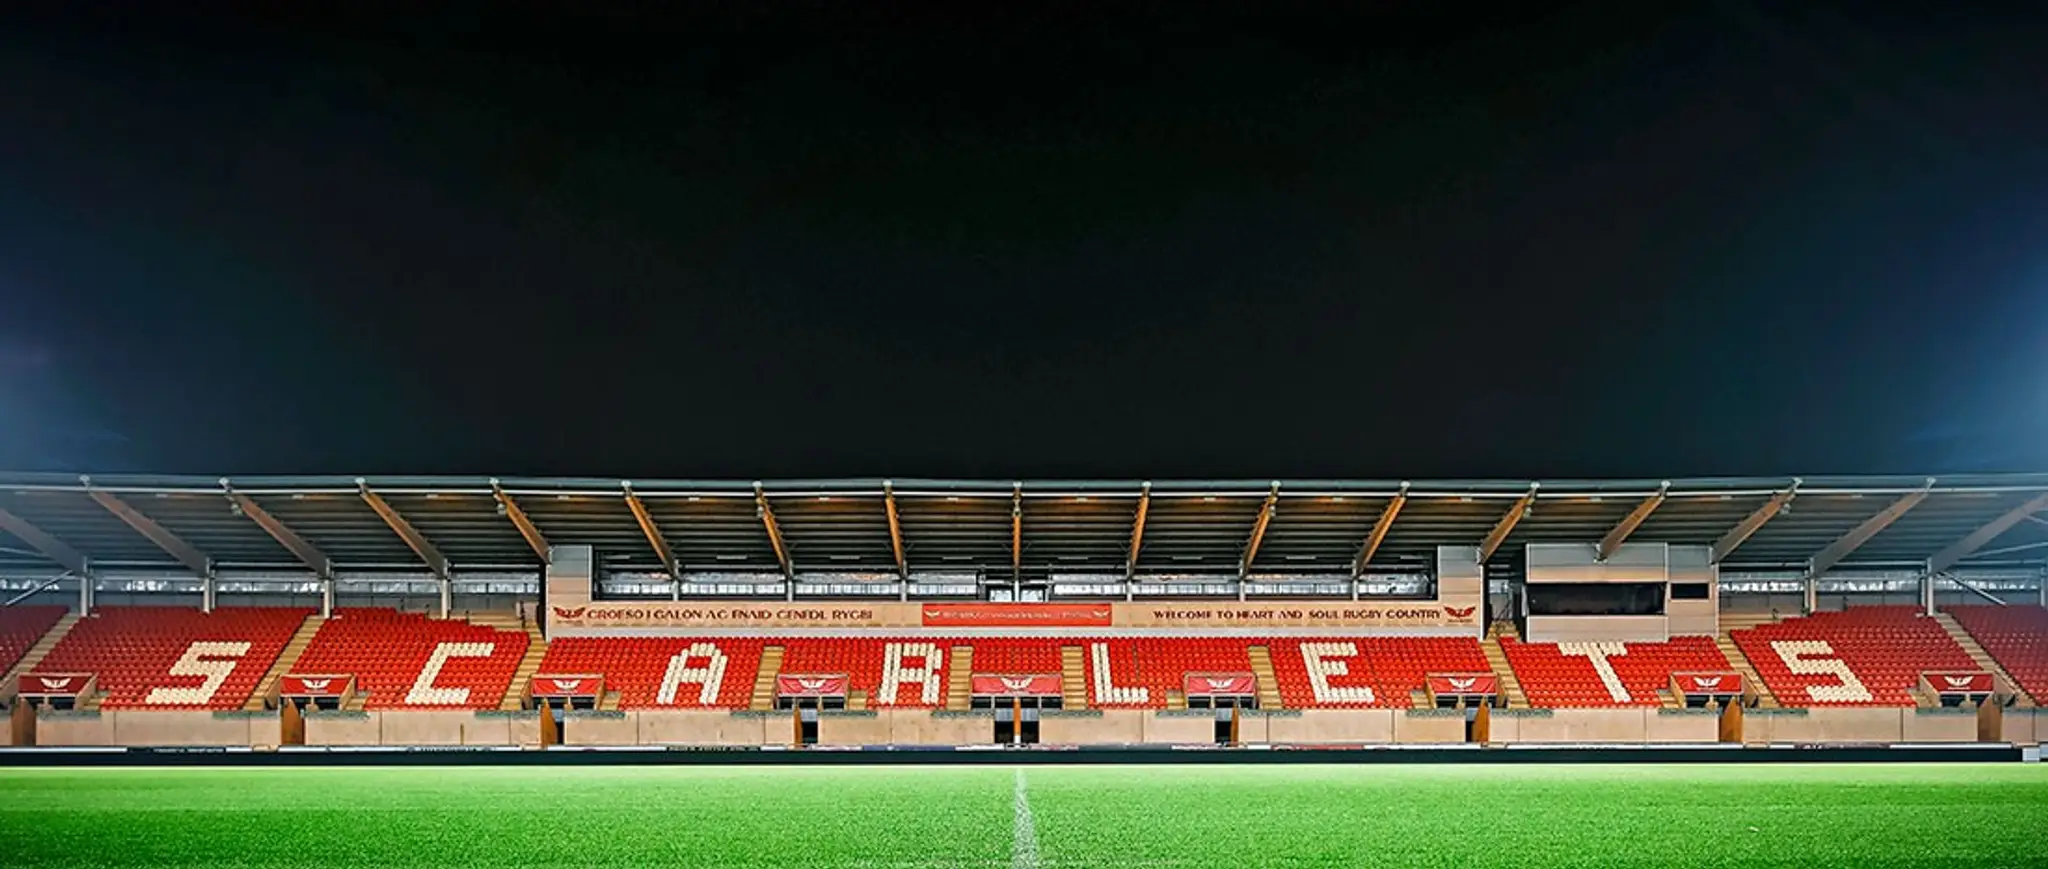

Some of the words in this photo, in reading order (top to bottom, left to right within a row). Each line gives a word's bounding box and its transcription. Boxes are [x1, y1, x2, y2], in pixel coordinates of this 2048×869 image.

[653, 609, 701, 619] GALON
[1153, 610, 1211, 619] WELCOME
[1217, 610, 1234, 619] TO
[1236, 610, 1274, 619] HEART
[1278, 610, 1303, 619] AND
[1308, 609, 1340, 619] SOUL
[1343, 609, 1381, 619] RUGBY
[1385, 609, 1440, 619] COUNTRY
